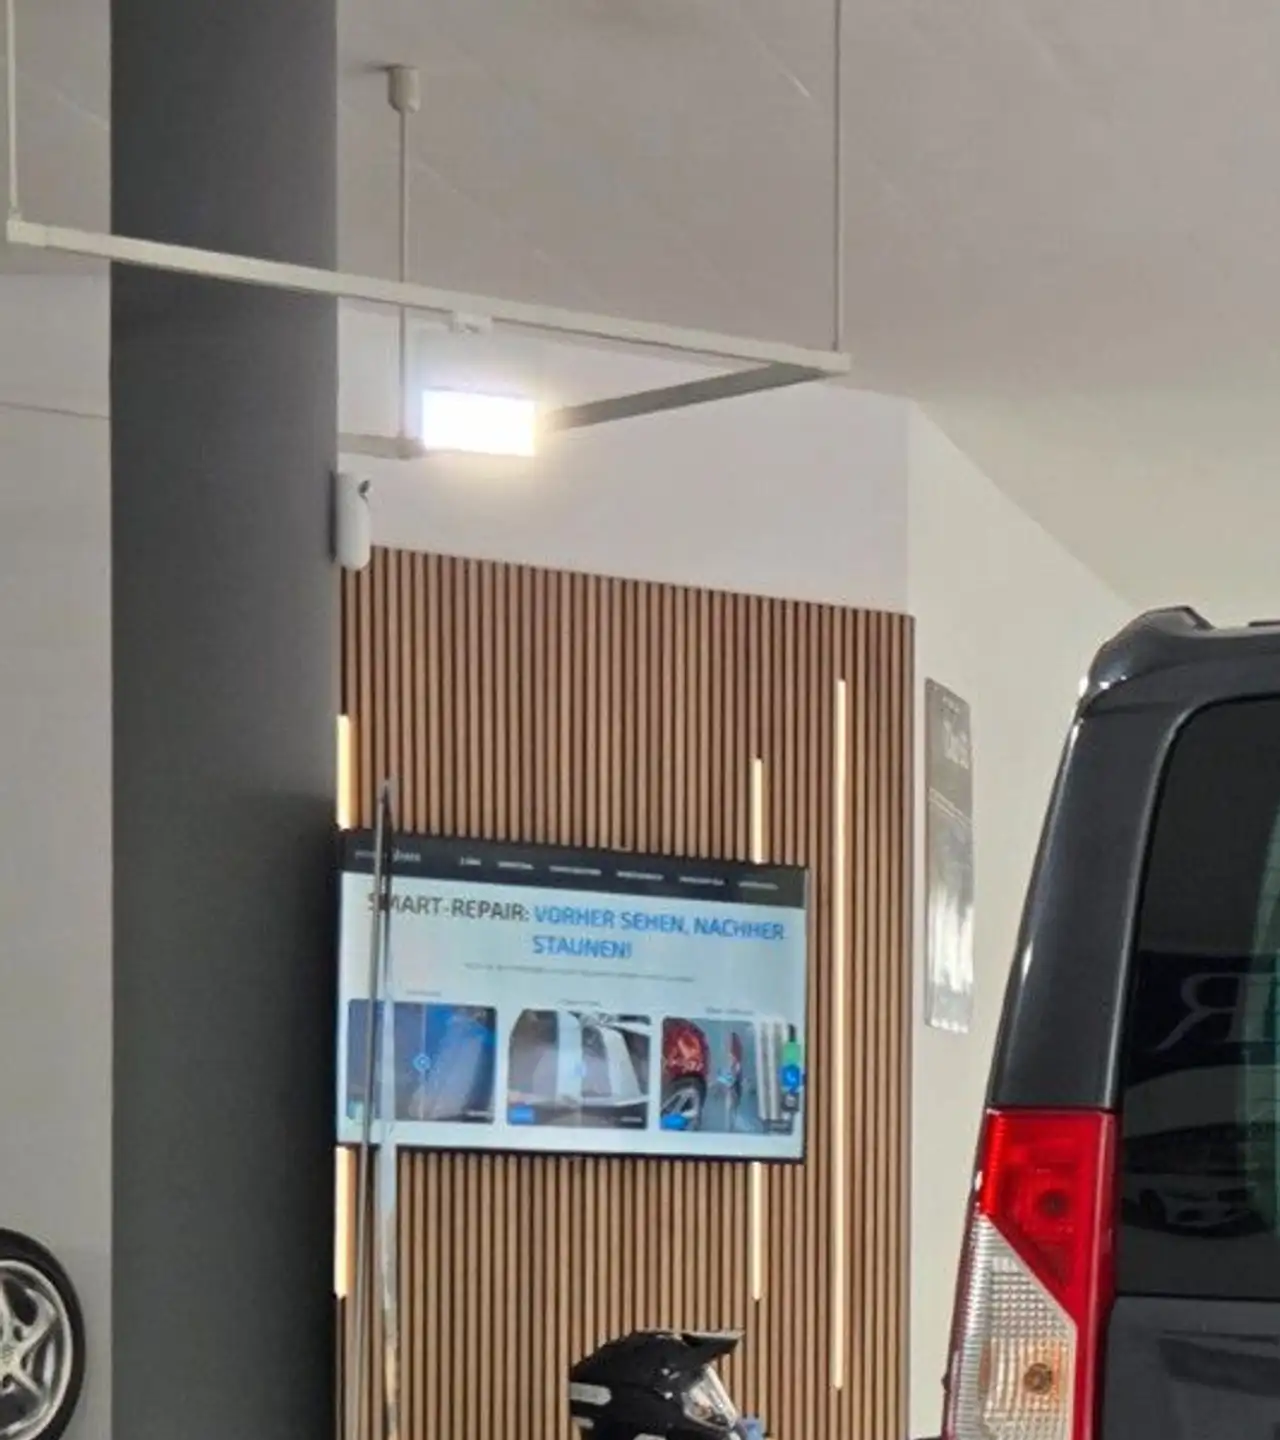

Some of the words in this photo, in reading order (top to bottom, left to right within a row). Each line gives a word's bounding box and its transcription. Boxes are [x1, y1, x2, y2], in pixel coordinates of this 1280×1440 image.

[534, 906, 614, 930] VORHER
[620, 911, 689, 936] SEHEN,
[694, 917, 784, 940] NACHHER
[532, 936, 633, 960] STAUNEN!
